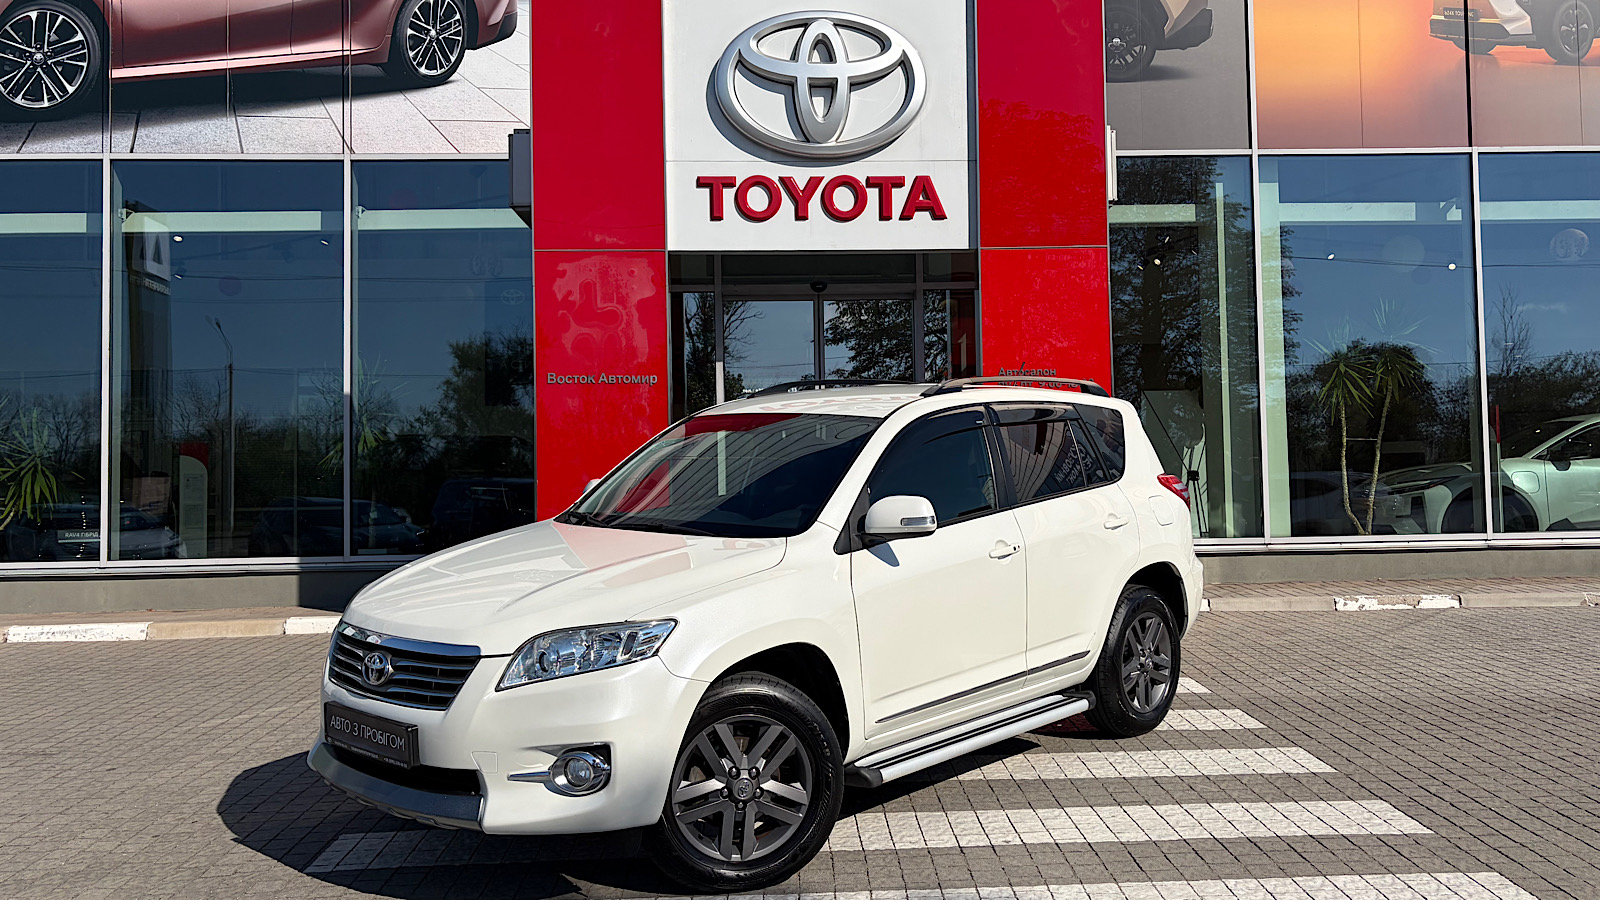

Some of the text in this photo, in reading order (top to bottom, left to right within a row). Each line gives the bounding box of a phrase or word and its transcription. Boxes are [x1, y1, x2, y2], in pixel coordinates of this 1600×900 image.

[696, 174, 948, 223] TOYOTA
[547, 372, 658, 386] Восток Автомир
[330, 715, 351, 733] АВТО
[360, 724, 405, 752] ПРОБІГОМ
